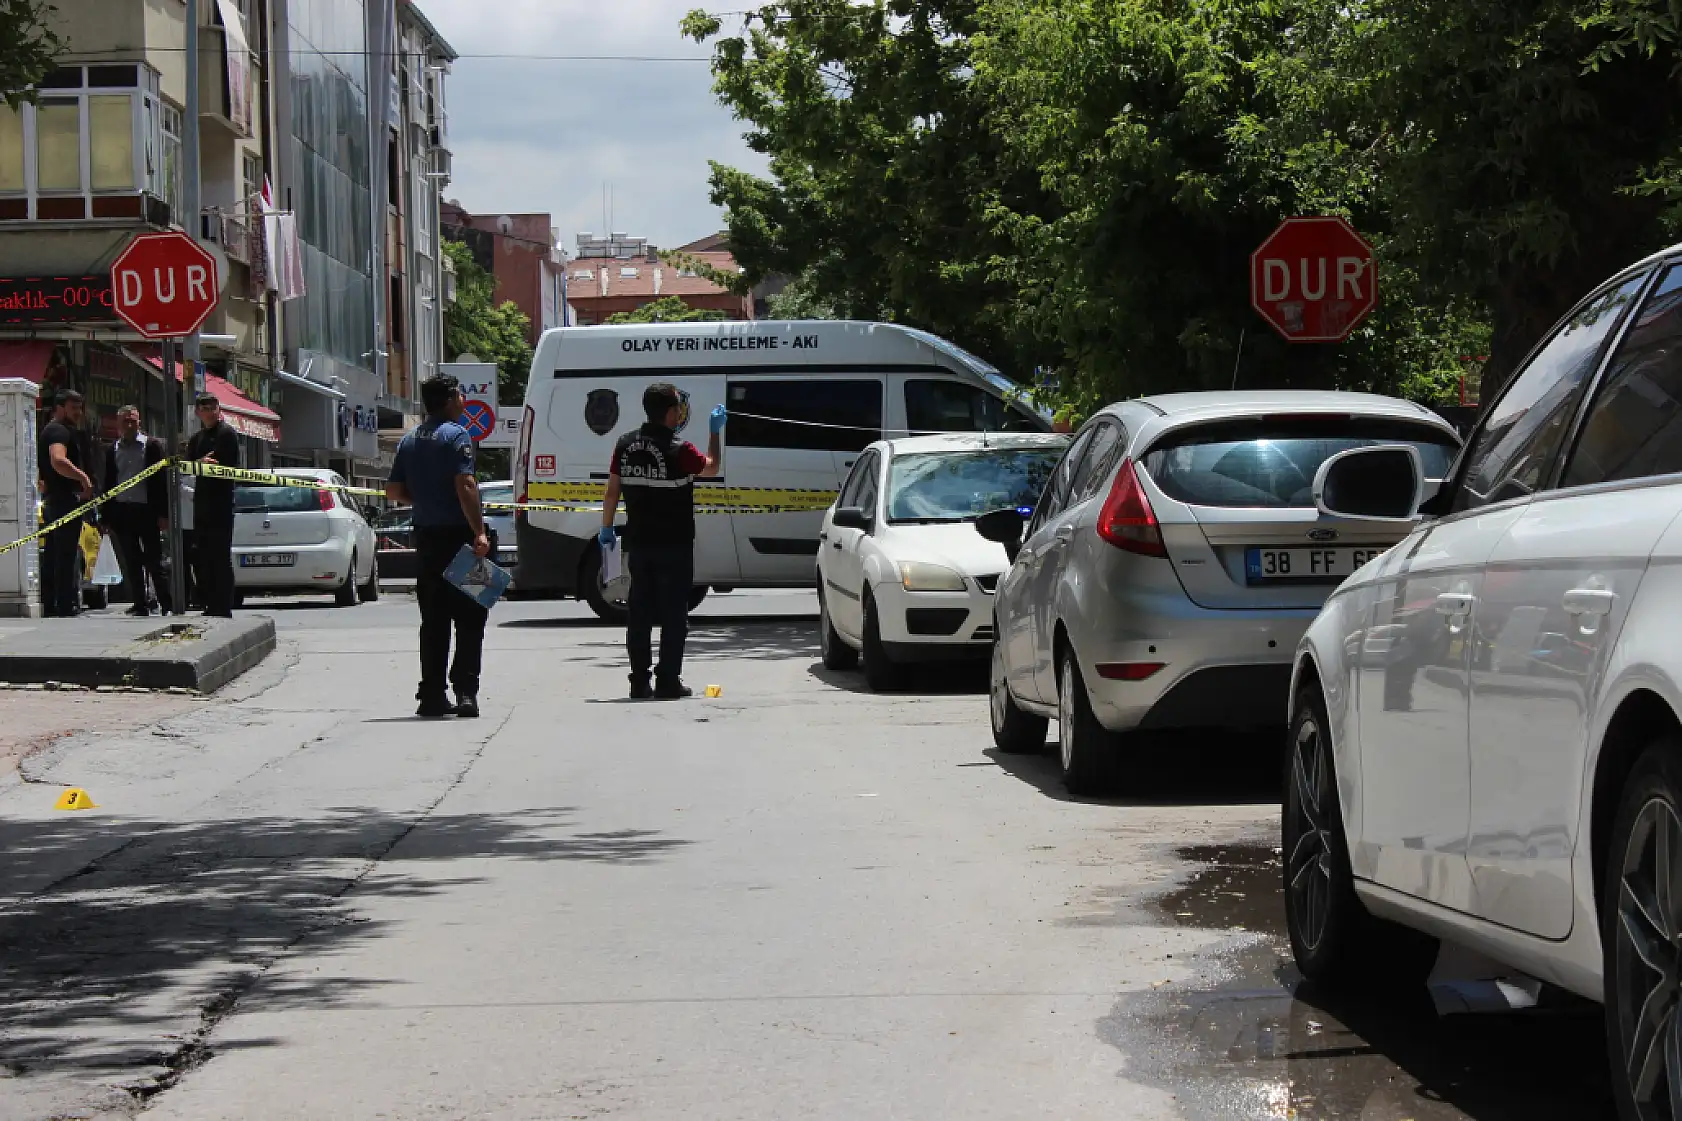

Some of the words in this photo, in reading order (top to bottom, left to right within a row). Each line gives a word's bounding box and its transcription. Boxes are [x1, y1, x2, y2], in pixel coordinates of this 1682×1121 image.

[121, 265, 208, 306] DUR
[1263, 256, 1363, 301] DUR
[621, 339, 661, 352] OLAY
[1264, 551, 1291, 574] 38
[1310, 550, 1336, 574] FF
[67, 792, 78, 804] 3
